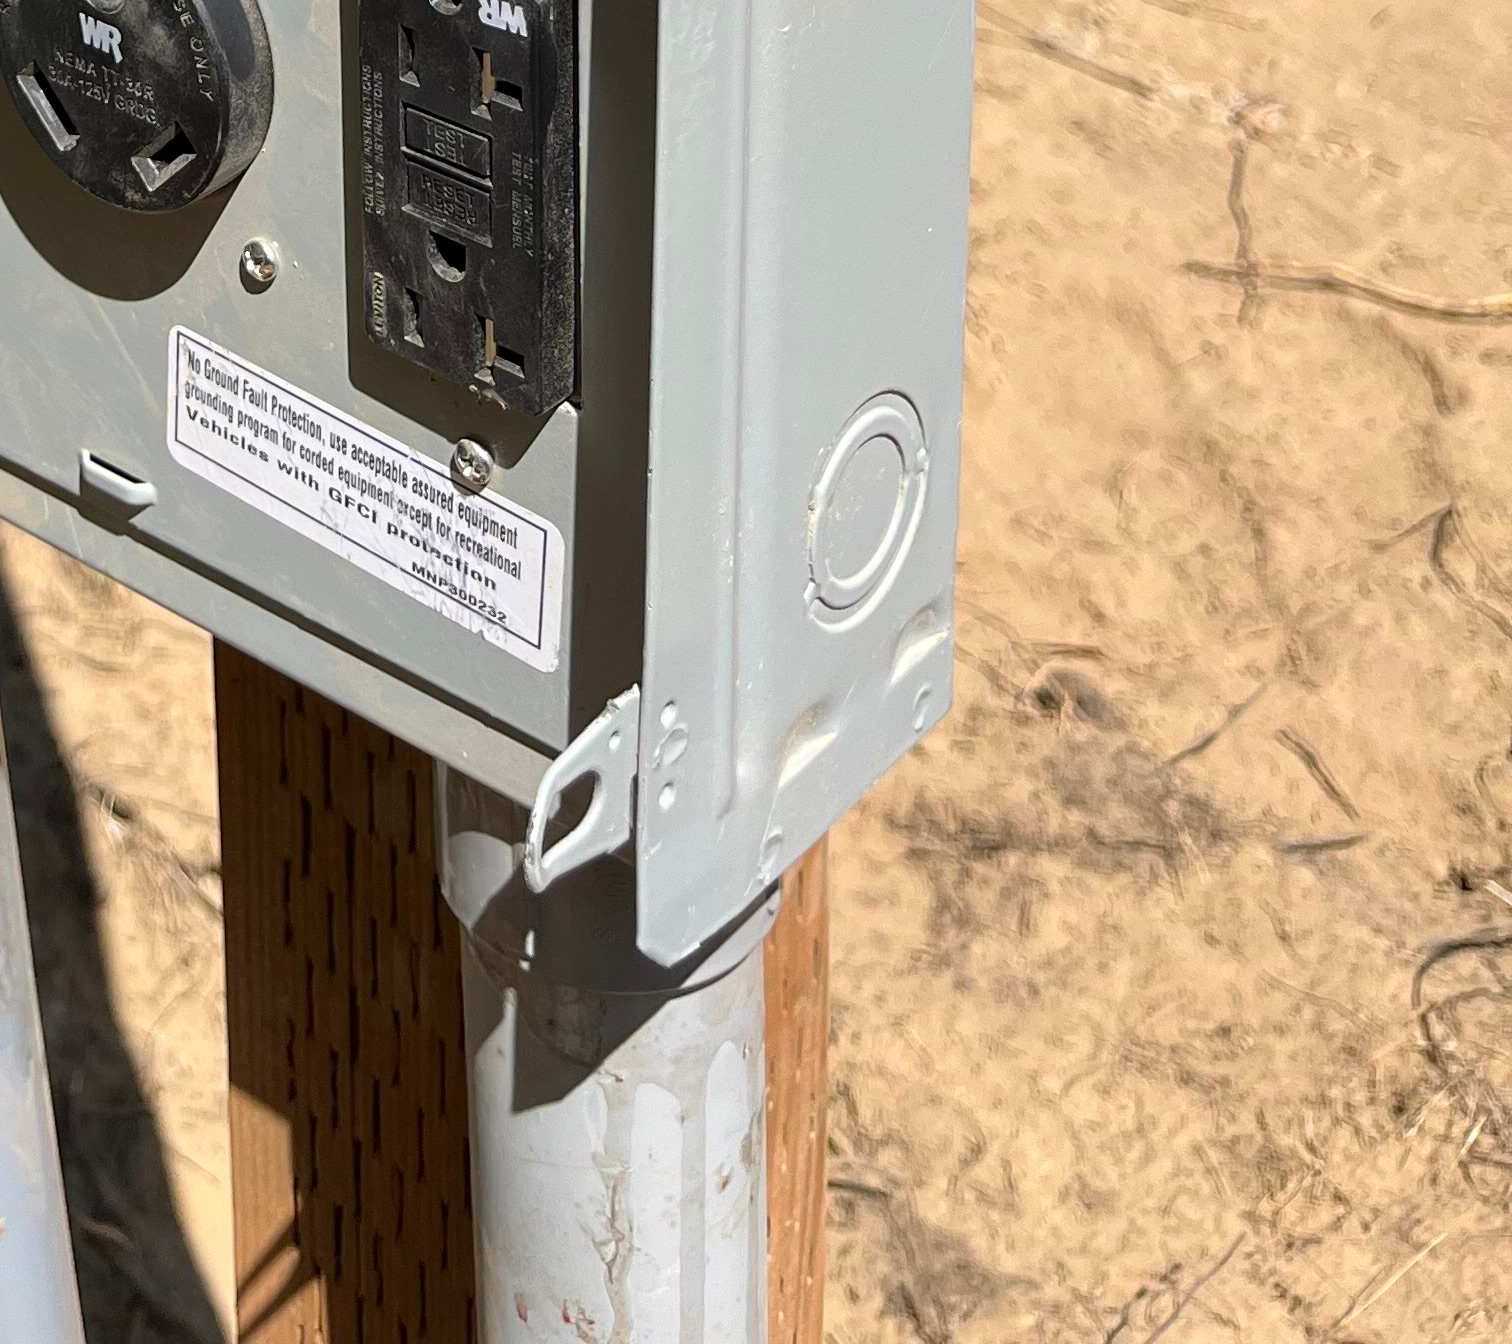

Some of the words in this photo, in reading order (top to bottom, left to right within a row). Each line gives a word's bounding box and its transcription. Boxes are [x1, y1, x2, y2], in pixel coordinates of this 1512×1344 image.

[79, 12, 123, 64] WR
[190, 36, 215, 102] ONLY
[184, 377, 233, 424] grounding
[237, 408, 278, 448] program
[282, 430, 296, 455] for
[299, 440, 334, 476] corded
[337, 462, 393, 512] equipment
[397, 496, 432, 534] except
[435, 515, 451, 541] for
[454, 526, 521, 580] recreational
[185, 404, 269, 462] Vehicles
[277, 456, 319, 491] with
[328, 485, 376, 524] GFCI
[386, 519, 497, 592] protection
[187, 348, 200, 375] No
[204, 356, 239, 396] Ground
[242, 377, 268, 412] Fault
[329, 430, 347, 456] use
[350, 439, 408, 493] acceptable
[411, 472, 454, 514] assured
[457, 497, 517, 552] equipment
[411, 560, 507, 625] MNP300232
